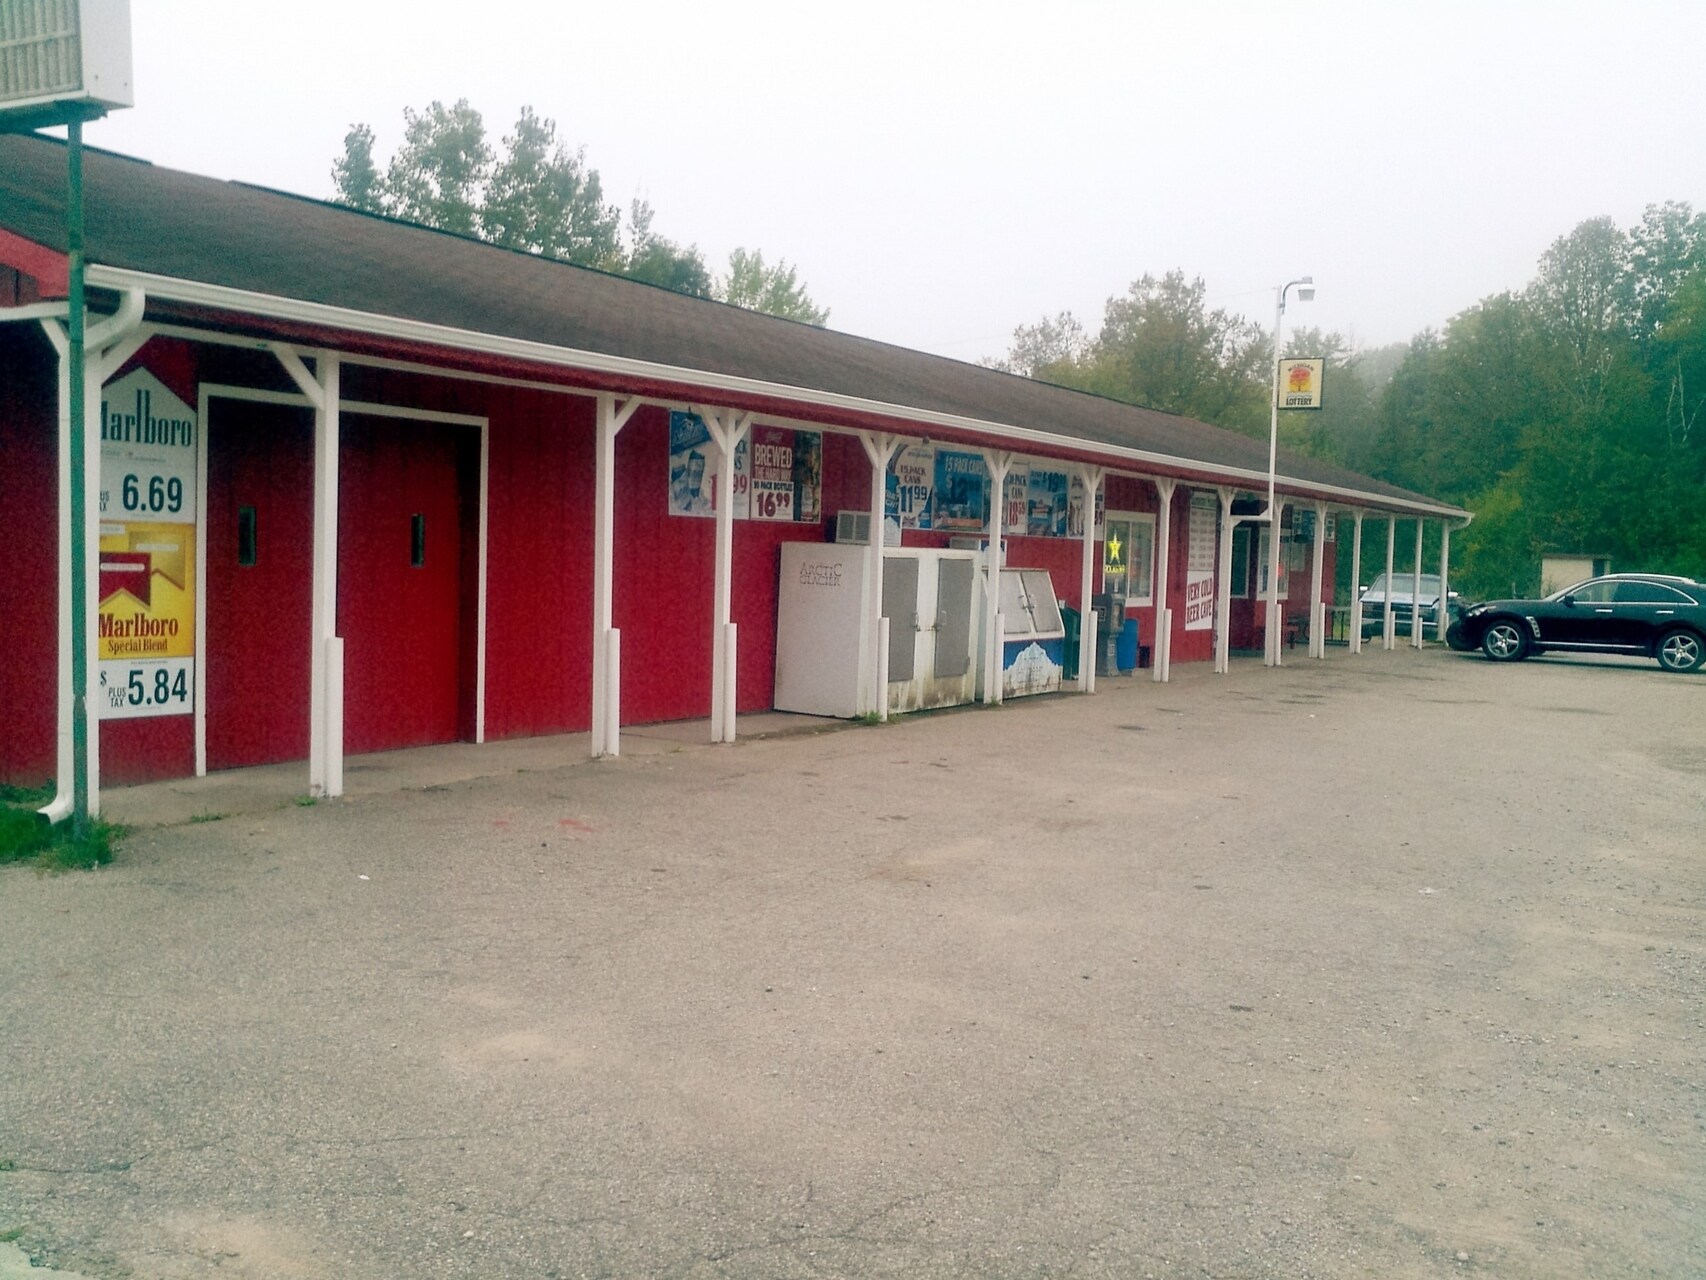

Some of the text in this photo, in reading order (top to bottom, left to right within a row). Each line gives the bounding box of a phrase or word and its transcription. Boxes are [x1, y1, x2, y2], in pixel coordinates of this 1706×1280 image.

[1286, 398, 1312, 406] LOTTERY
[755, 444, 793, 469] BREWED
[911, 466, 926, 476] PACK
[122, 473, 183, 513] 6.69
[800, 575, 841, 586] GLACIER
[1188, 578, 1212, 602] VERY COLD
[1187, 599, 1212, 625] BEER CAVE
[99, 613, 178, 638] Marlboro
[108, 639, 168, 655] Special Blend
[100, 668, 188, 706] $ 5.84
[108, 687, 127, 698] PLUS
[111, 698, 124, 708] TAX
